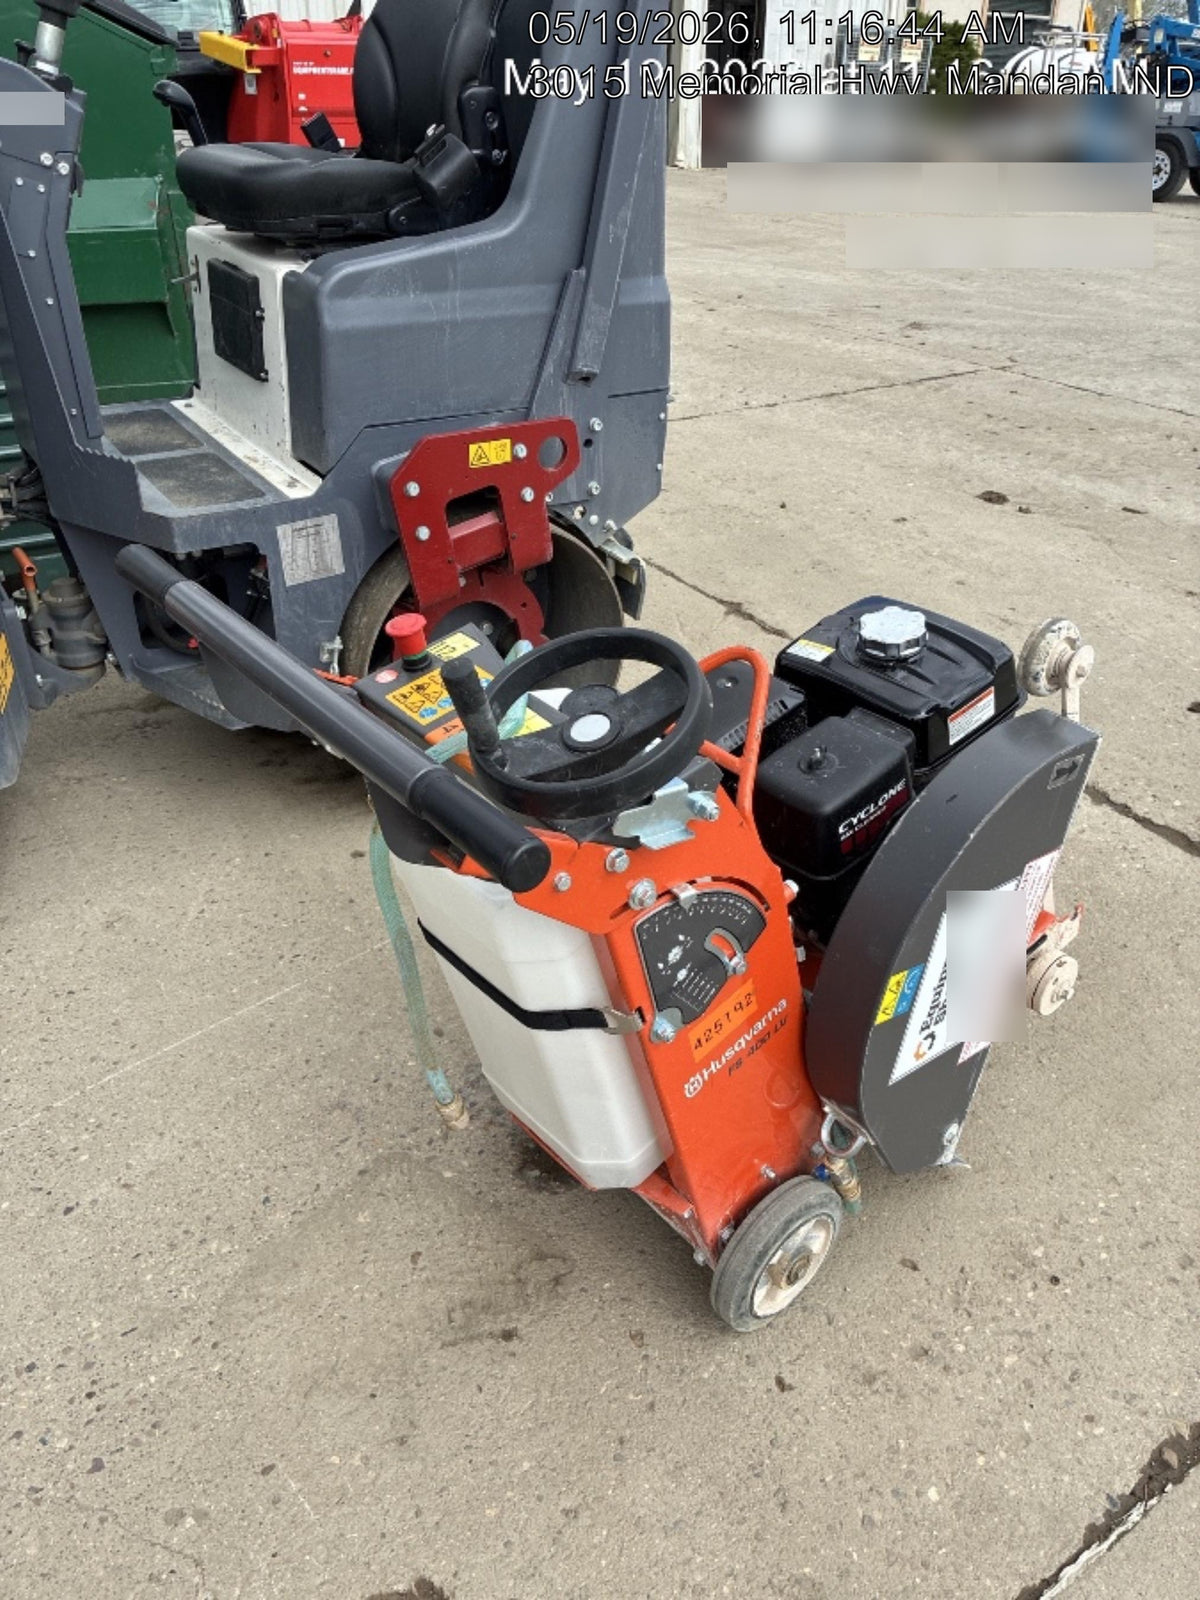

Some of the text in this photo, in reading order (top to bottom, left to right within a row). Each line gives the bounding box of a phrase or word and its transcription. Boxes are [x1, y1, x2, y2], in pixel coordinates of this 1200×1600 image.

[838, 778, 907, 835] CYCLONE
[693, 992, 754, 1050] 425192
[702, 998, 788, 1081] Husqvarna
